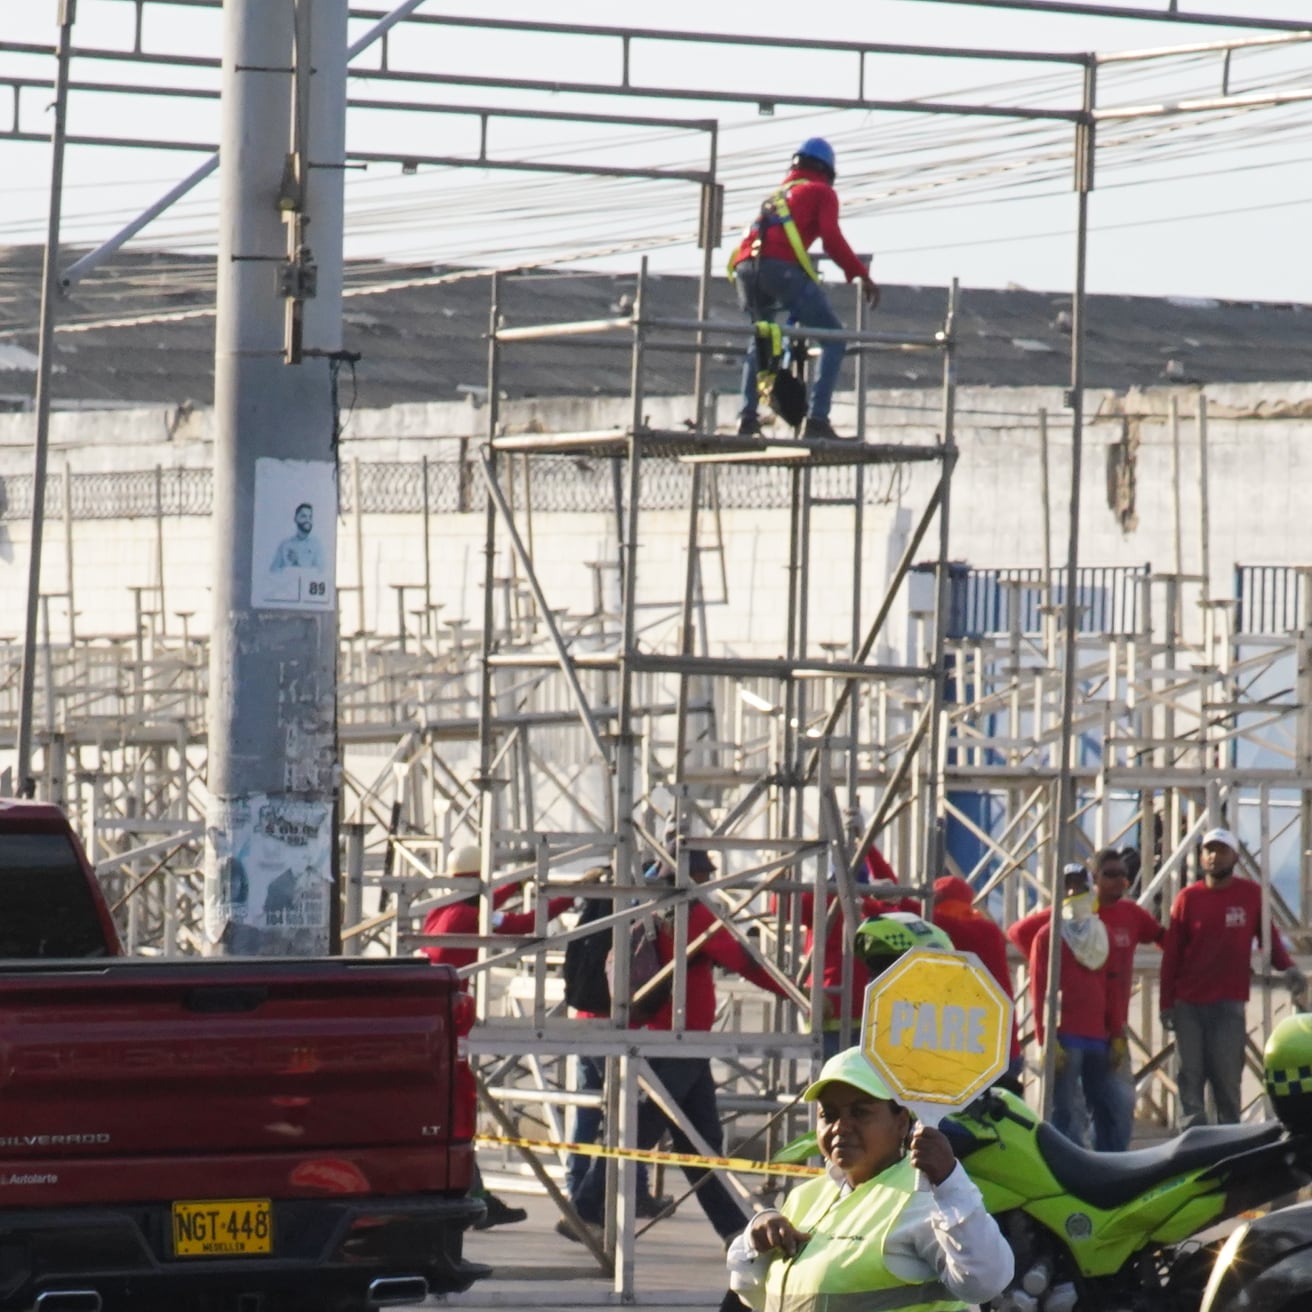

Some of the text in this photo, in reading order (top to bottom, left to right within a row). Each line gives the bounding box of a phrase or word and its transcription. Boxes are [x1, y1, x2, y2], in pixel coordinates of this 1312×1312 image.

[309, 582, 326, 596] 89
[889, 999, 988, 1054] PARE
[421, 1125, 441, 1136] LT
